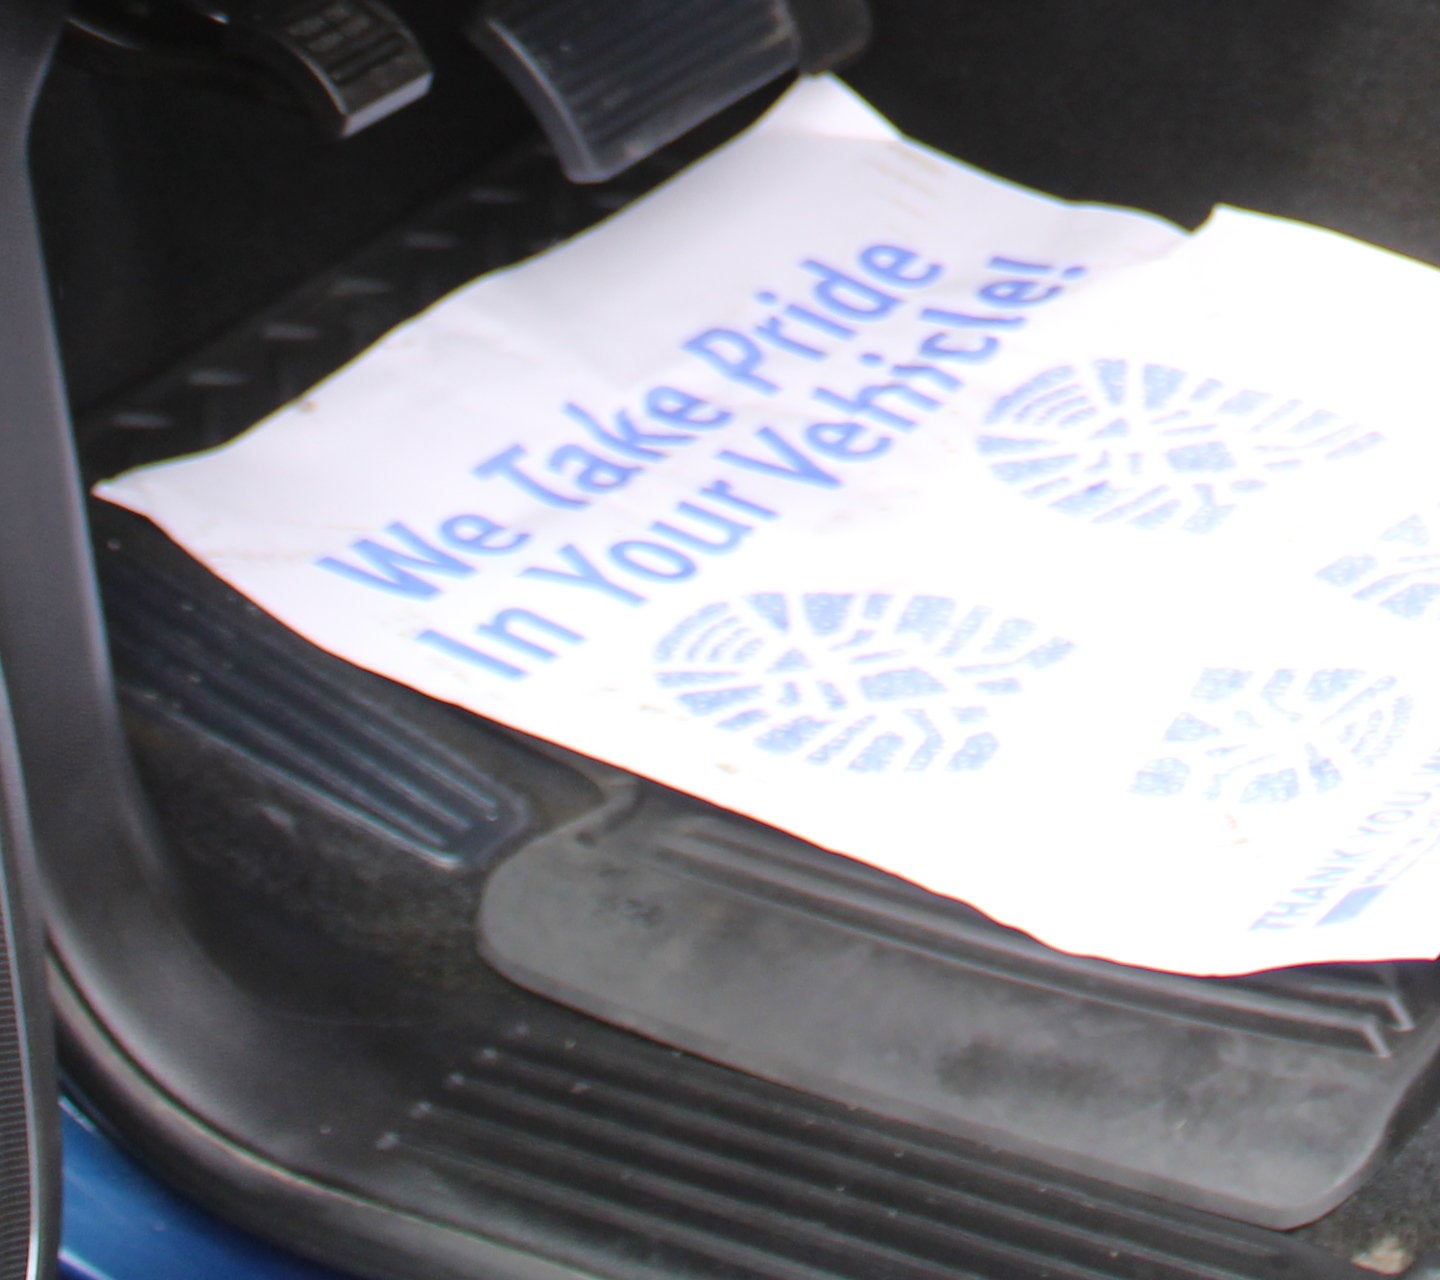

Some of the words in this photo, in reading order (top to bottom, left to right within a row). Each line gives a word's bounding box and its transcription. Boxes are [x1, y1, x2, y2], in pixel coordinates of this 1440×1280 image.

[314, 512, 531, 602] We
[471, 384, 735, 511] Take
[681, 241, 946, 396] Pride
[415, 602, 588, 682] In
[518, 476, 781, 607] Your
[714, 255, 1088, 490] Vehicle!
[1246, 848, 1377, 932] THANK
